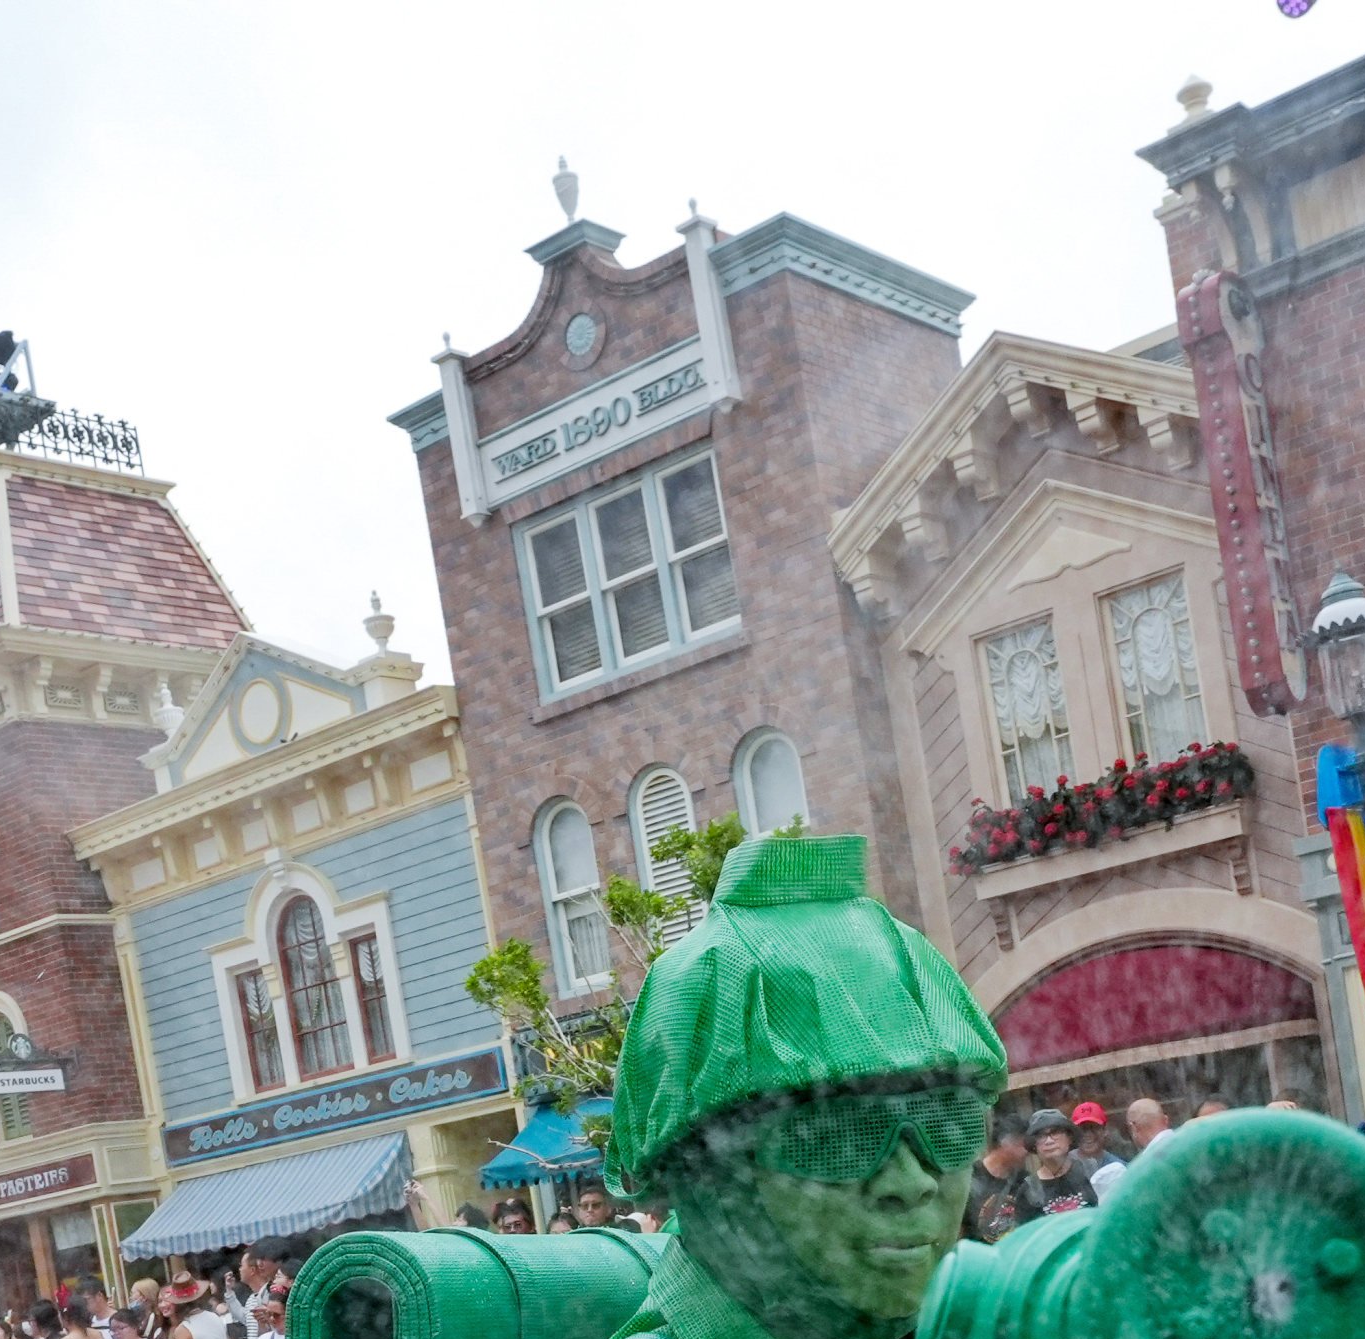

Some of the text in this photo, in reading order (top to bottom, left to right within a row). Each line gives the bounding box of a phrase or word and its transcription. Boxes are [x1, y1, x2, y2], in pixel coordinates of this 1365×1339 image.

[493, 434, 558, 476] WARD
[559, 396, 632, 452] 1890
[0, 1075, 56, 1087] STARBUCKS
[188, 1068, 473, 1152] Rolls Cookies Cakes
